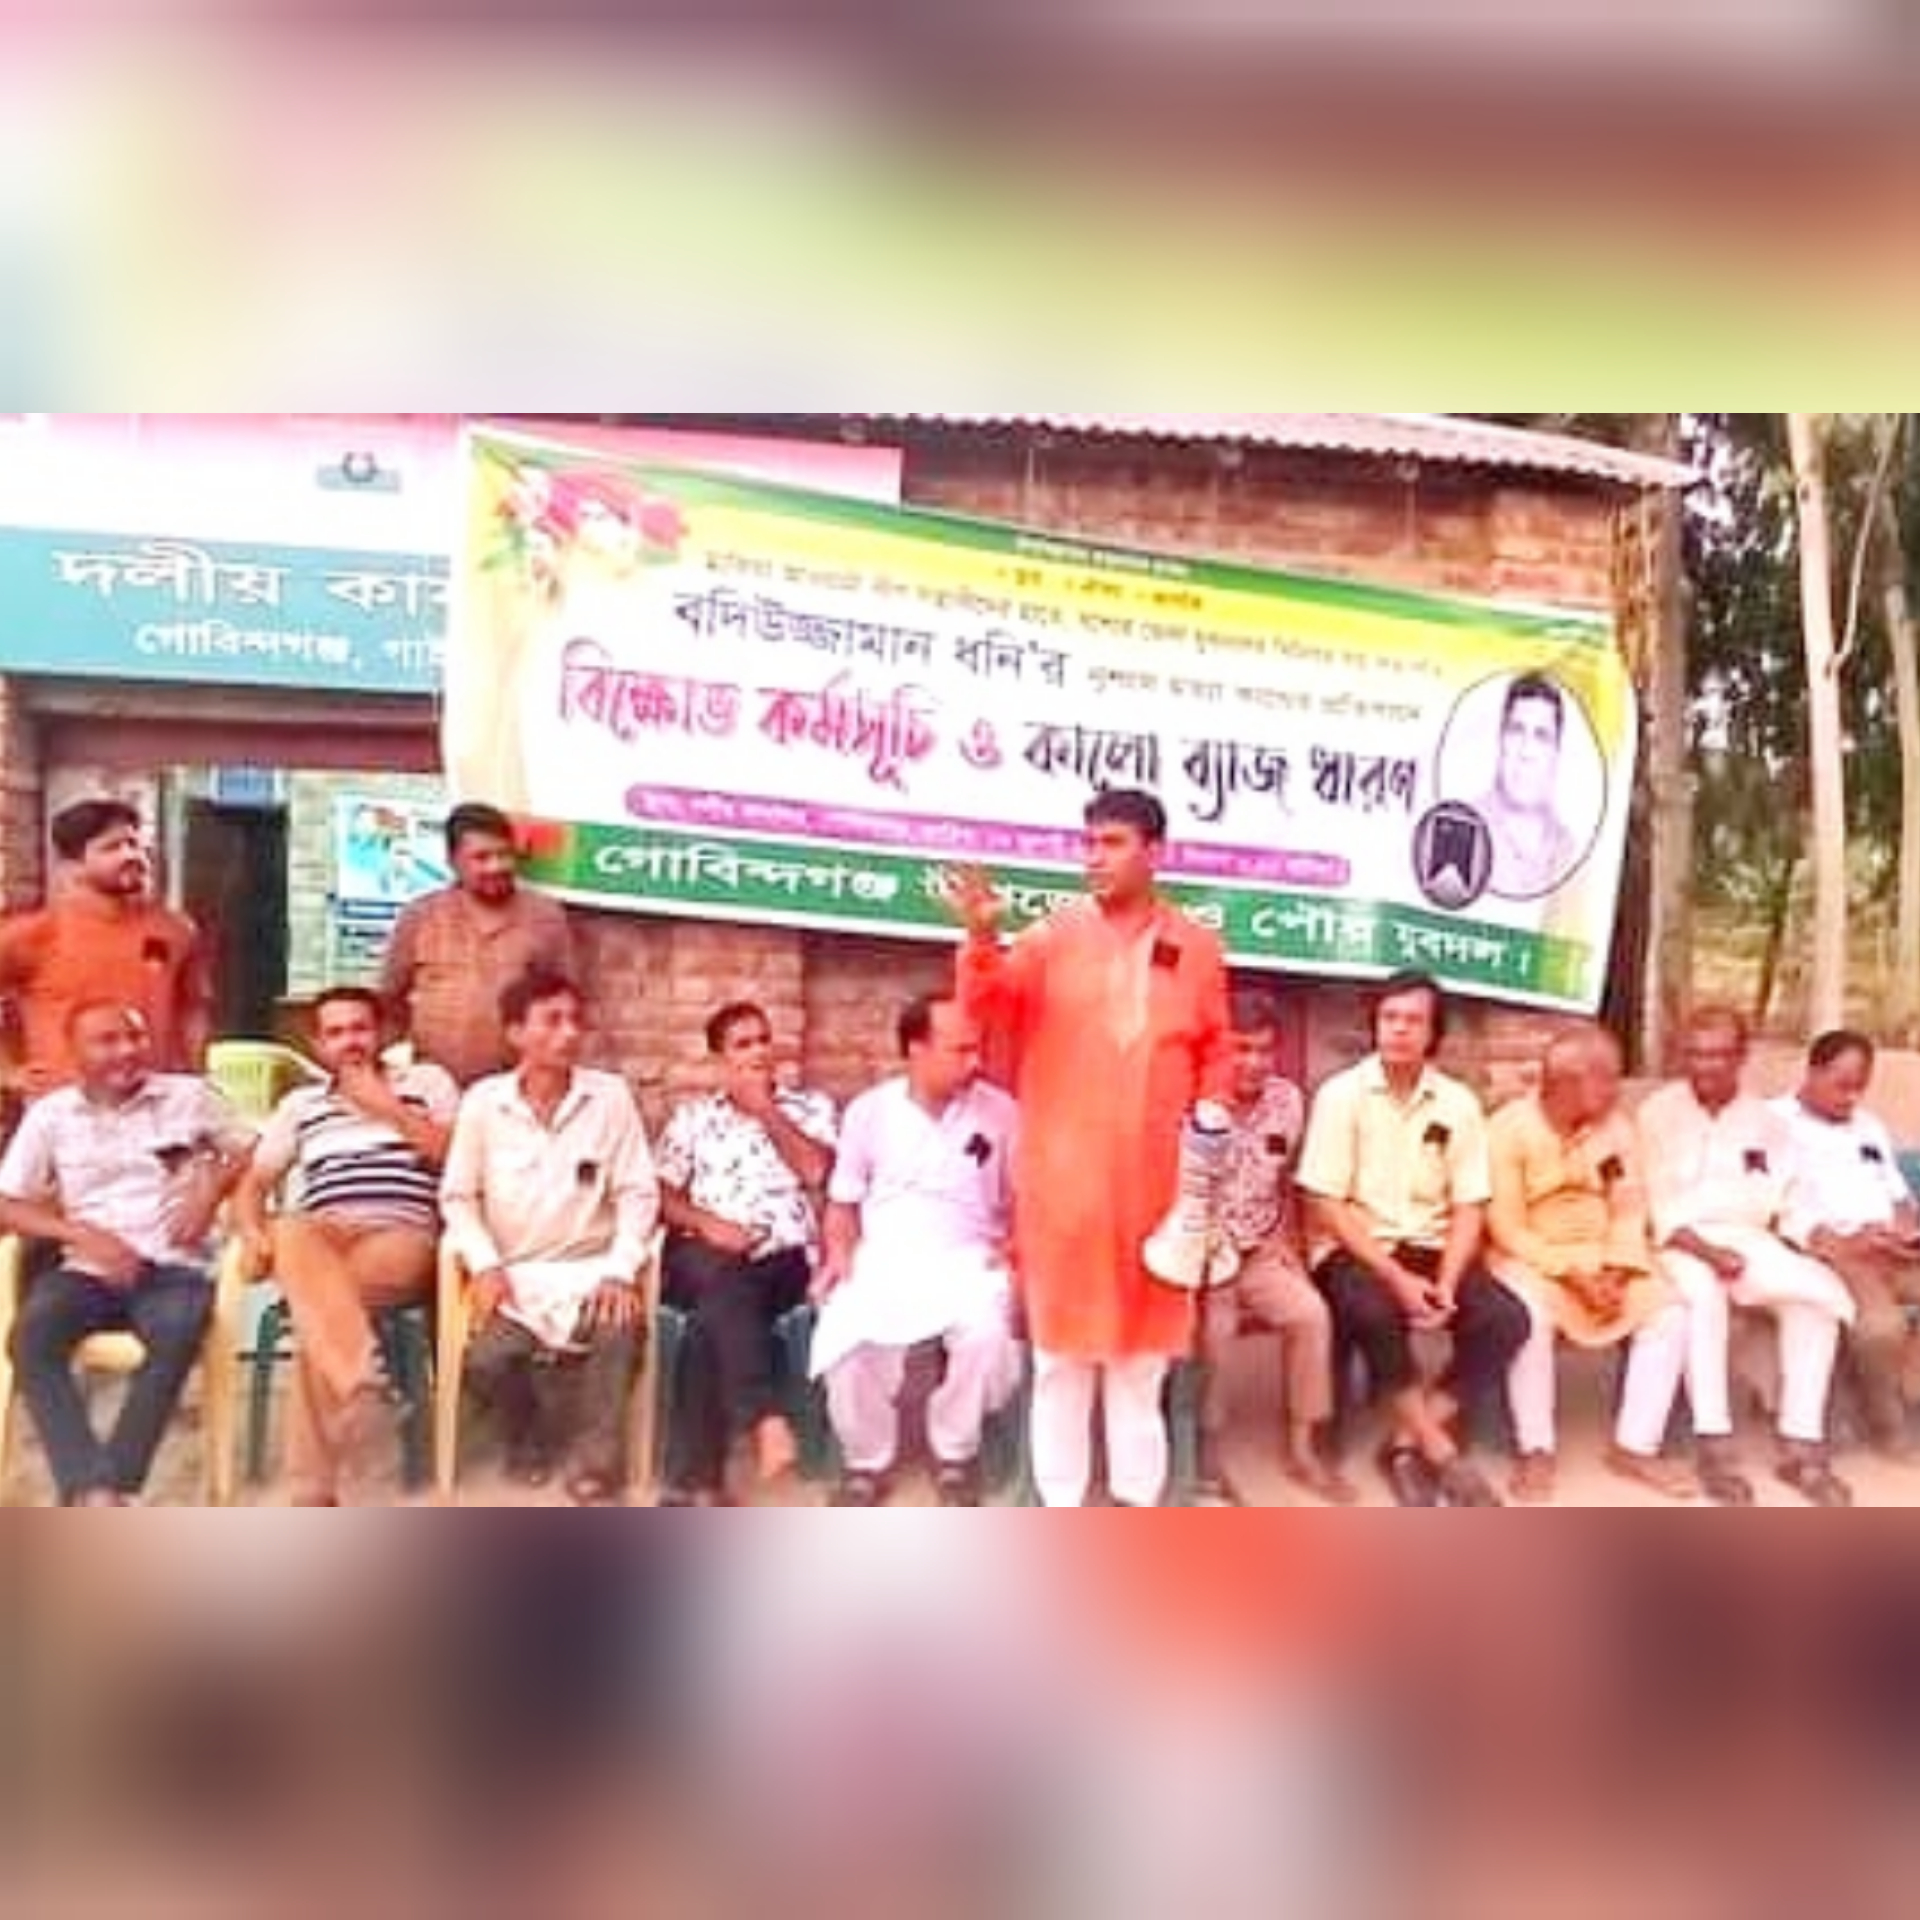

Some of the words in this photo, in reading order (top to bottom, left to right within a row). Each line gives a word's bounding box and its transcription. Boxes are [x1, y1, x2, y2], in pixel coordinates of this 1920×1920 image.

[51, 541, 292, 605] দলীয়
[673, 586, 938, 666] বদিউজ্জামান
[559, 636, 742, 741] বিক্ষোভ
[757, 668, 943, 793] কর্মসূচি
[958, 717, 1003, 770] ও
[1023, 722, 1162, 793] কালো
[1181, 736, 1292, 822] ব্যাজ
[1310, 744, 1418, 814] ধারণ
[595, 843, 899, 900] গোবিন্দগঞ্জ
[1251, 897, 1373, 954] পৌর
[1394, 919, 1507, 968] যুবদল
